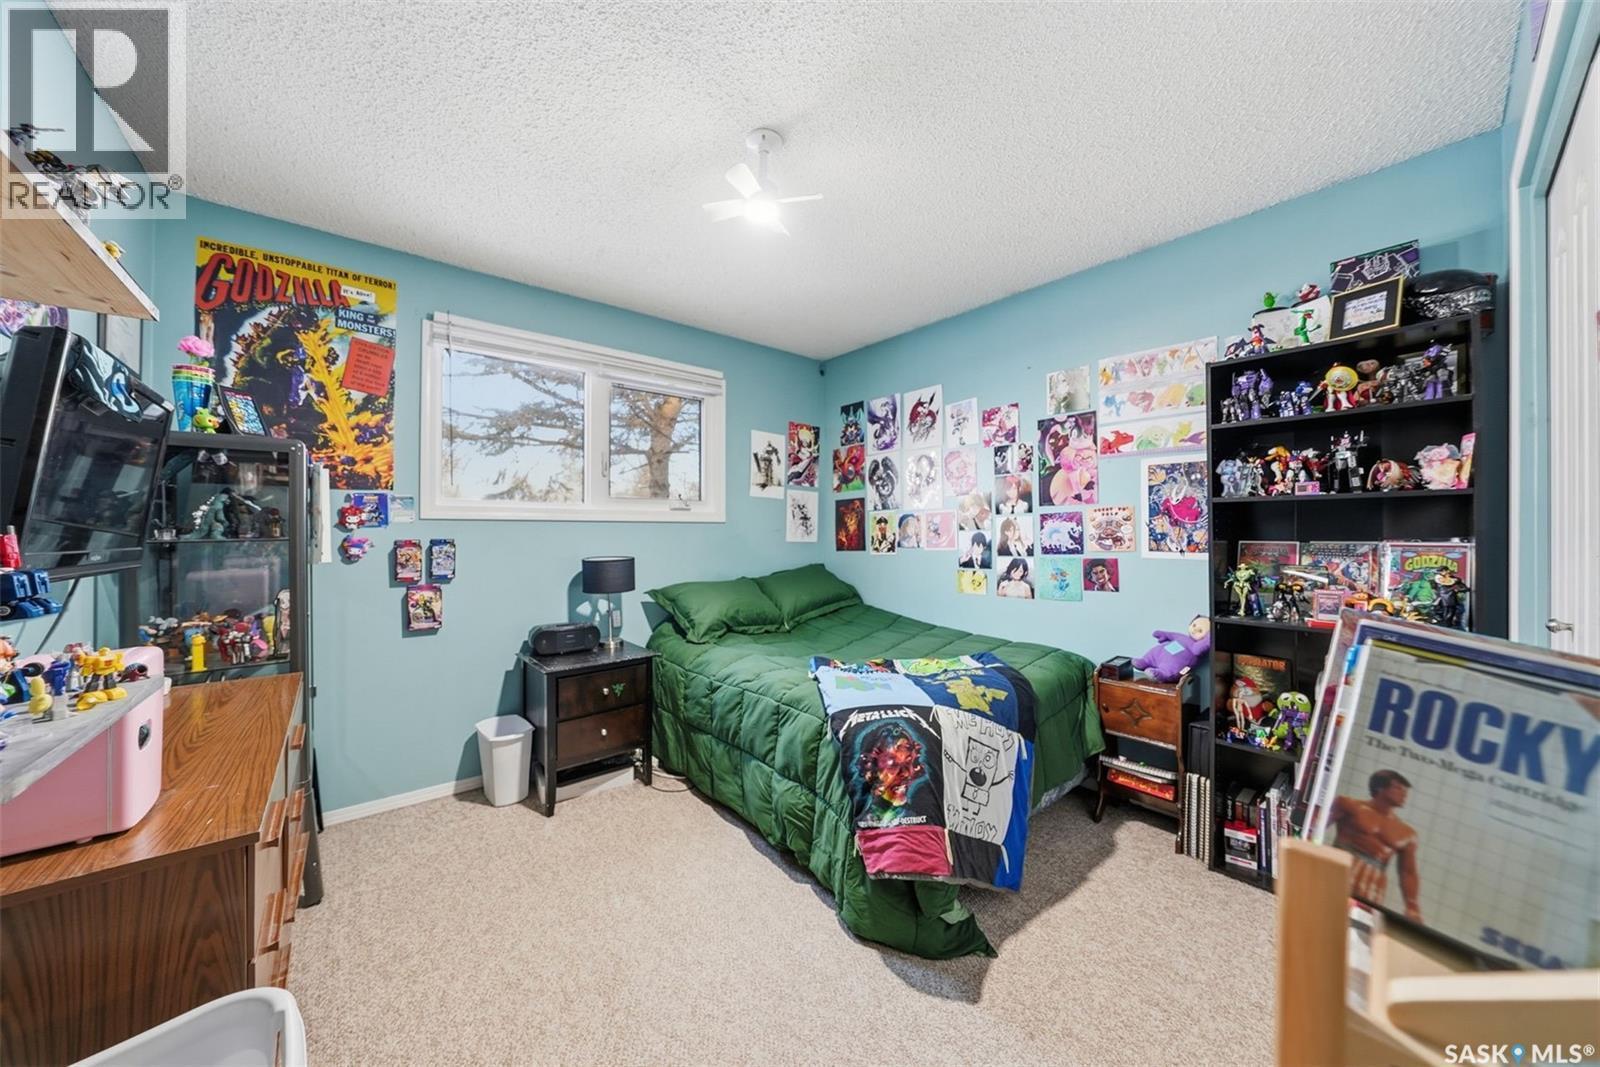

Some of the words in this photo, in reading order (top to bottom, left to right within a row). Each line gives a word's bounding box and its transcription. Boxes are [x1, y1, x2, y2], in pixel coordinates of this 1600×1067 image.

[195, 252, 351, 311] GODZILLA
[199, 240, 259, 261] INCREDIBLE,
[262, 253, 323, 274] UNSTOPPABLE
[325, 267, 349, 279] TITAN
[352, 274, 363, 283] OF
[364, 276, 397, 290] TERROR!
[337, 320, 396, 337] MONSTERS!
[338, 308, 364, 321] KING
[839, 706, 941, 742] METALLICA
[1368, 677, 1600, 796] ROCKY
[1365, 735, 1396, 751] The
[1400, 746, 1485, 783] Two-Mega
[1480, 926, 1564, 970] SEGA
